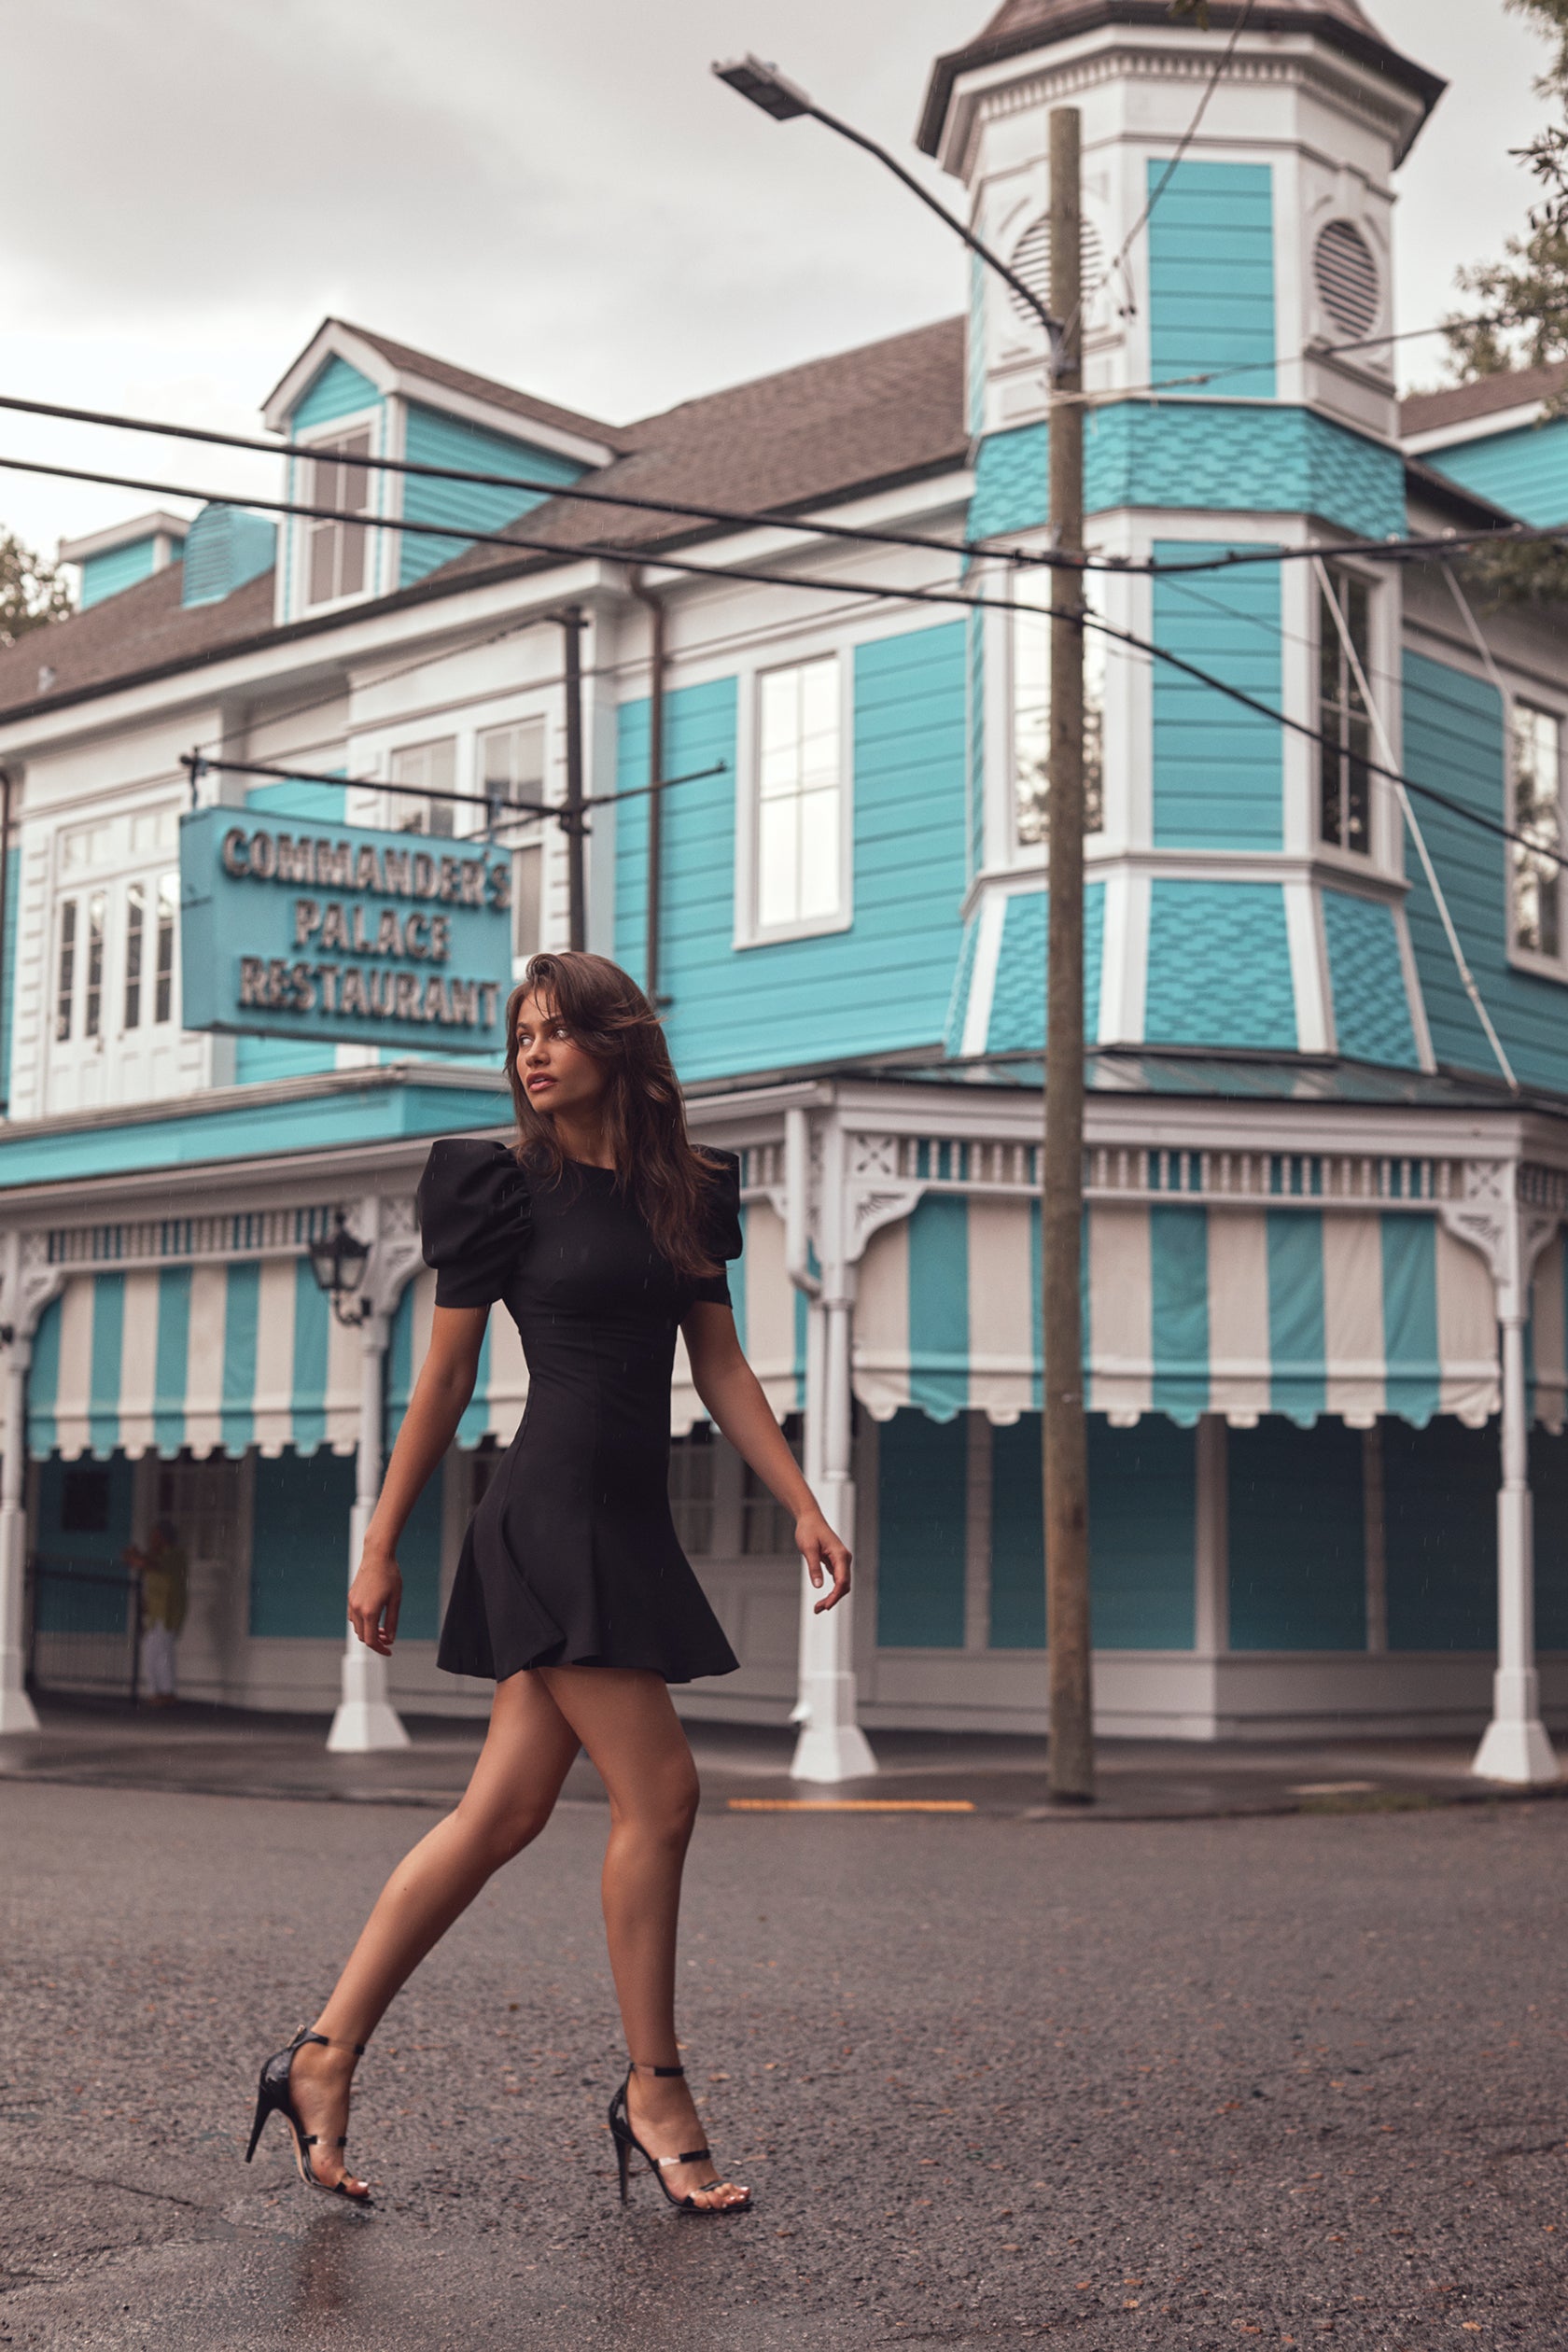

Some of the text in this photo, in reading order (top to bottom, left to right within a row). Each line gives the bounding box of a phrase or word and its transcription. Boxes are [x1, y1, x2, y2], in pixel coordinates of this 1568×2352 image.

[222, 827, 511, 908] COMMANDER'S
[294, 899, 451, 961] PALACE
[240, 956, 500, 1026] RESTAURANT
